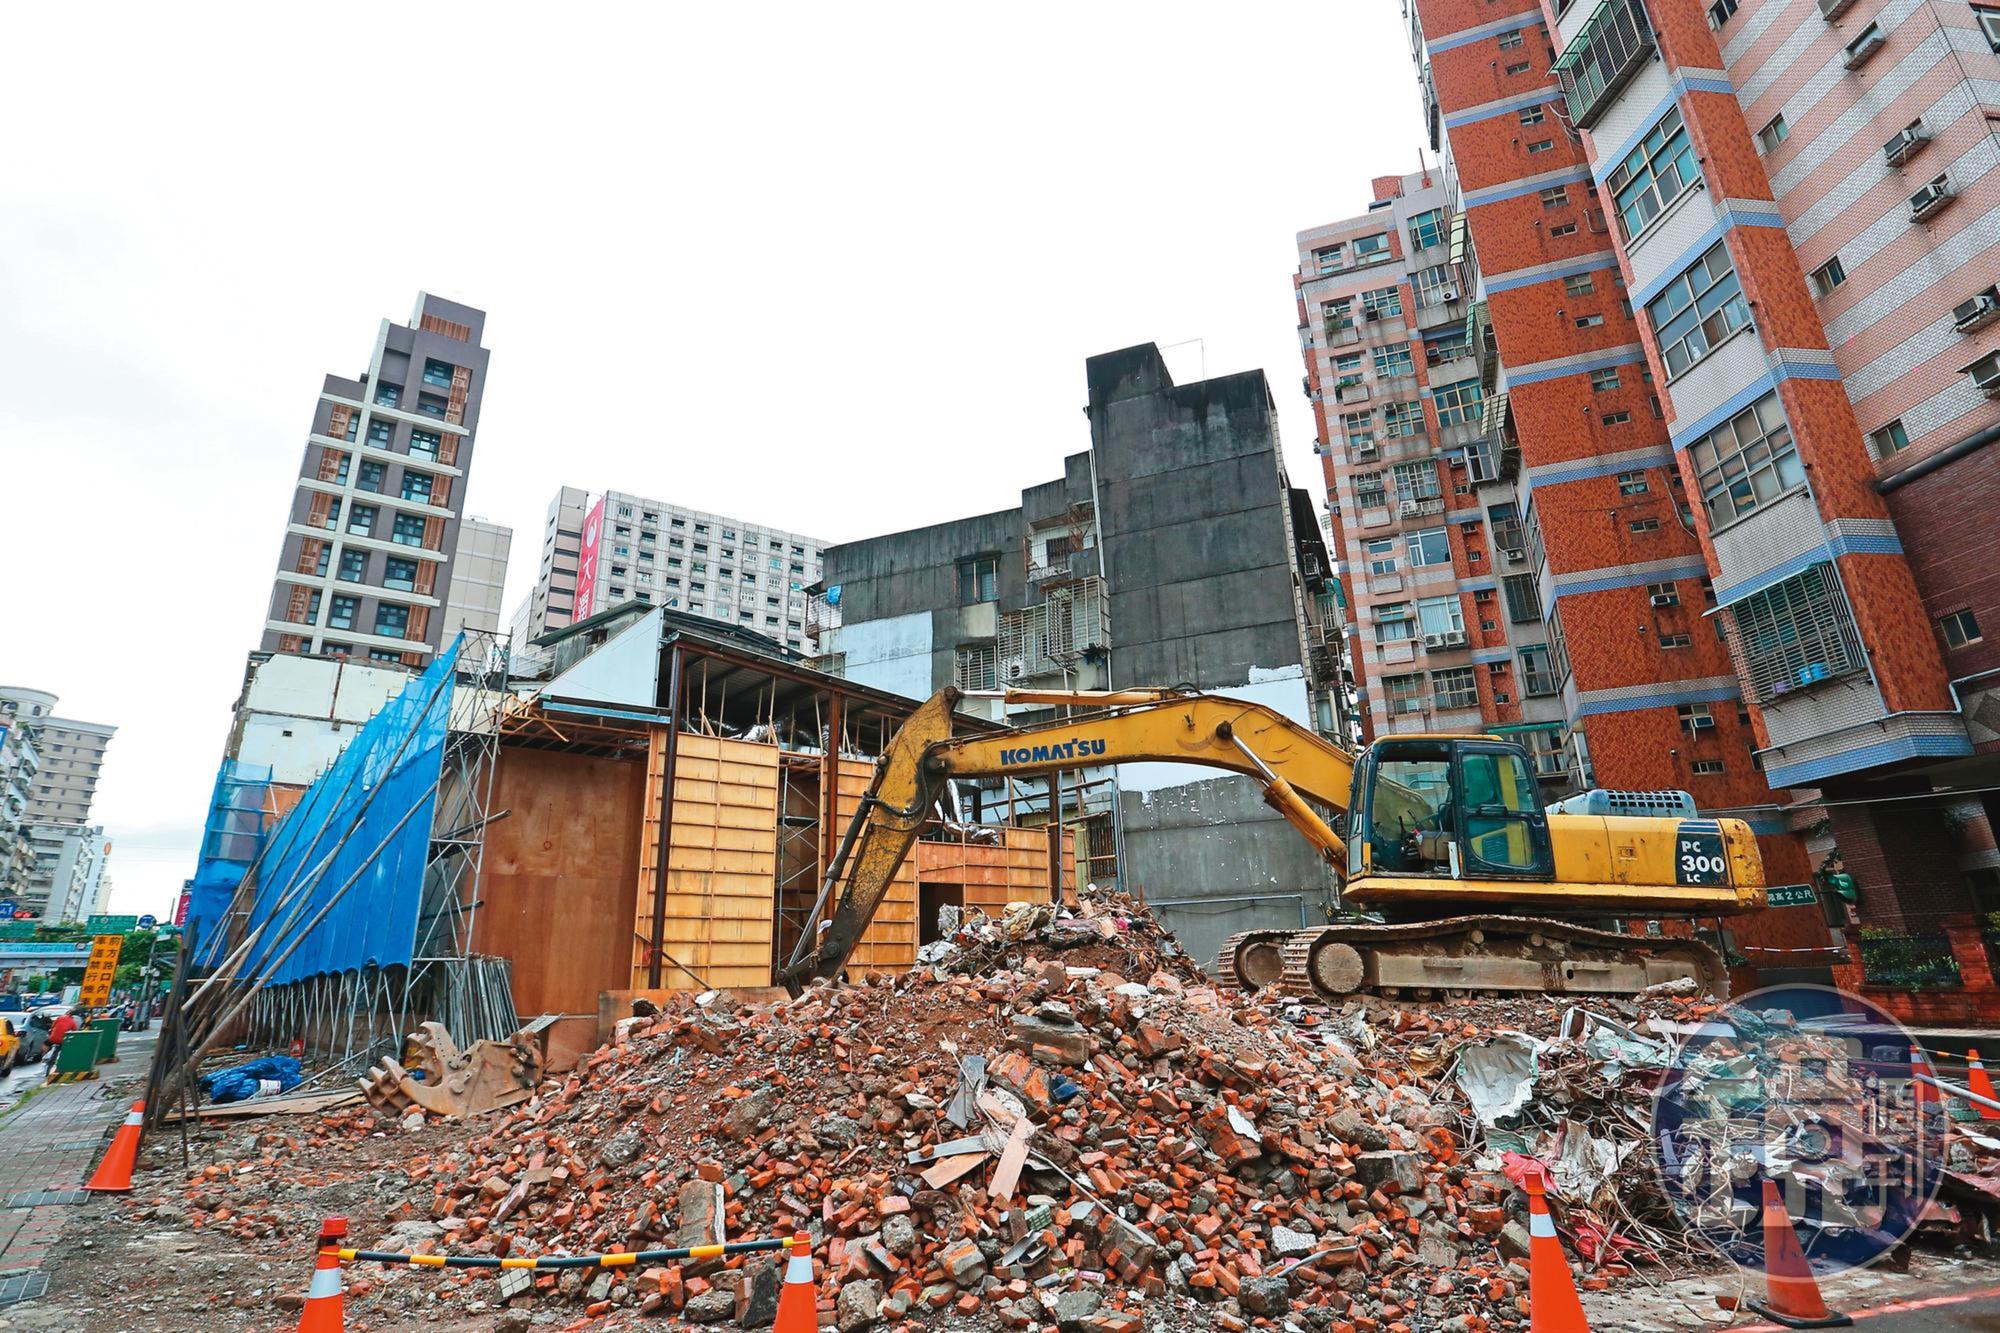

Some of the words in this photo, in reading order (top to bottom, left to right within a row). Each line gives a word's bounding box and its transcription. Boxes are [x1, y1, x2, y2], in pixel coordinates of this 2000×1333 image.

[1000, 738, 1106, 766] KOMATSU
[1681, 840, 1701, 853] PC
[1681, 855, 1725, 873] 300
[1687, 874, 1701, 883] LC
